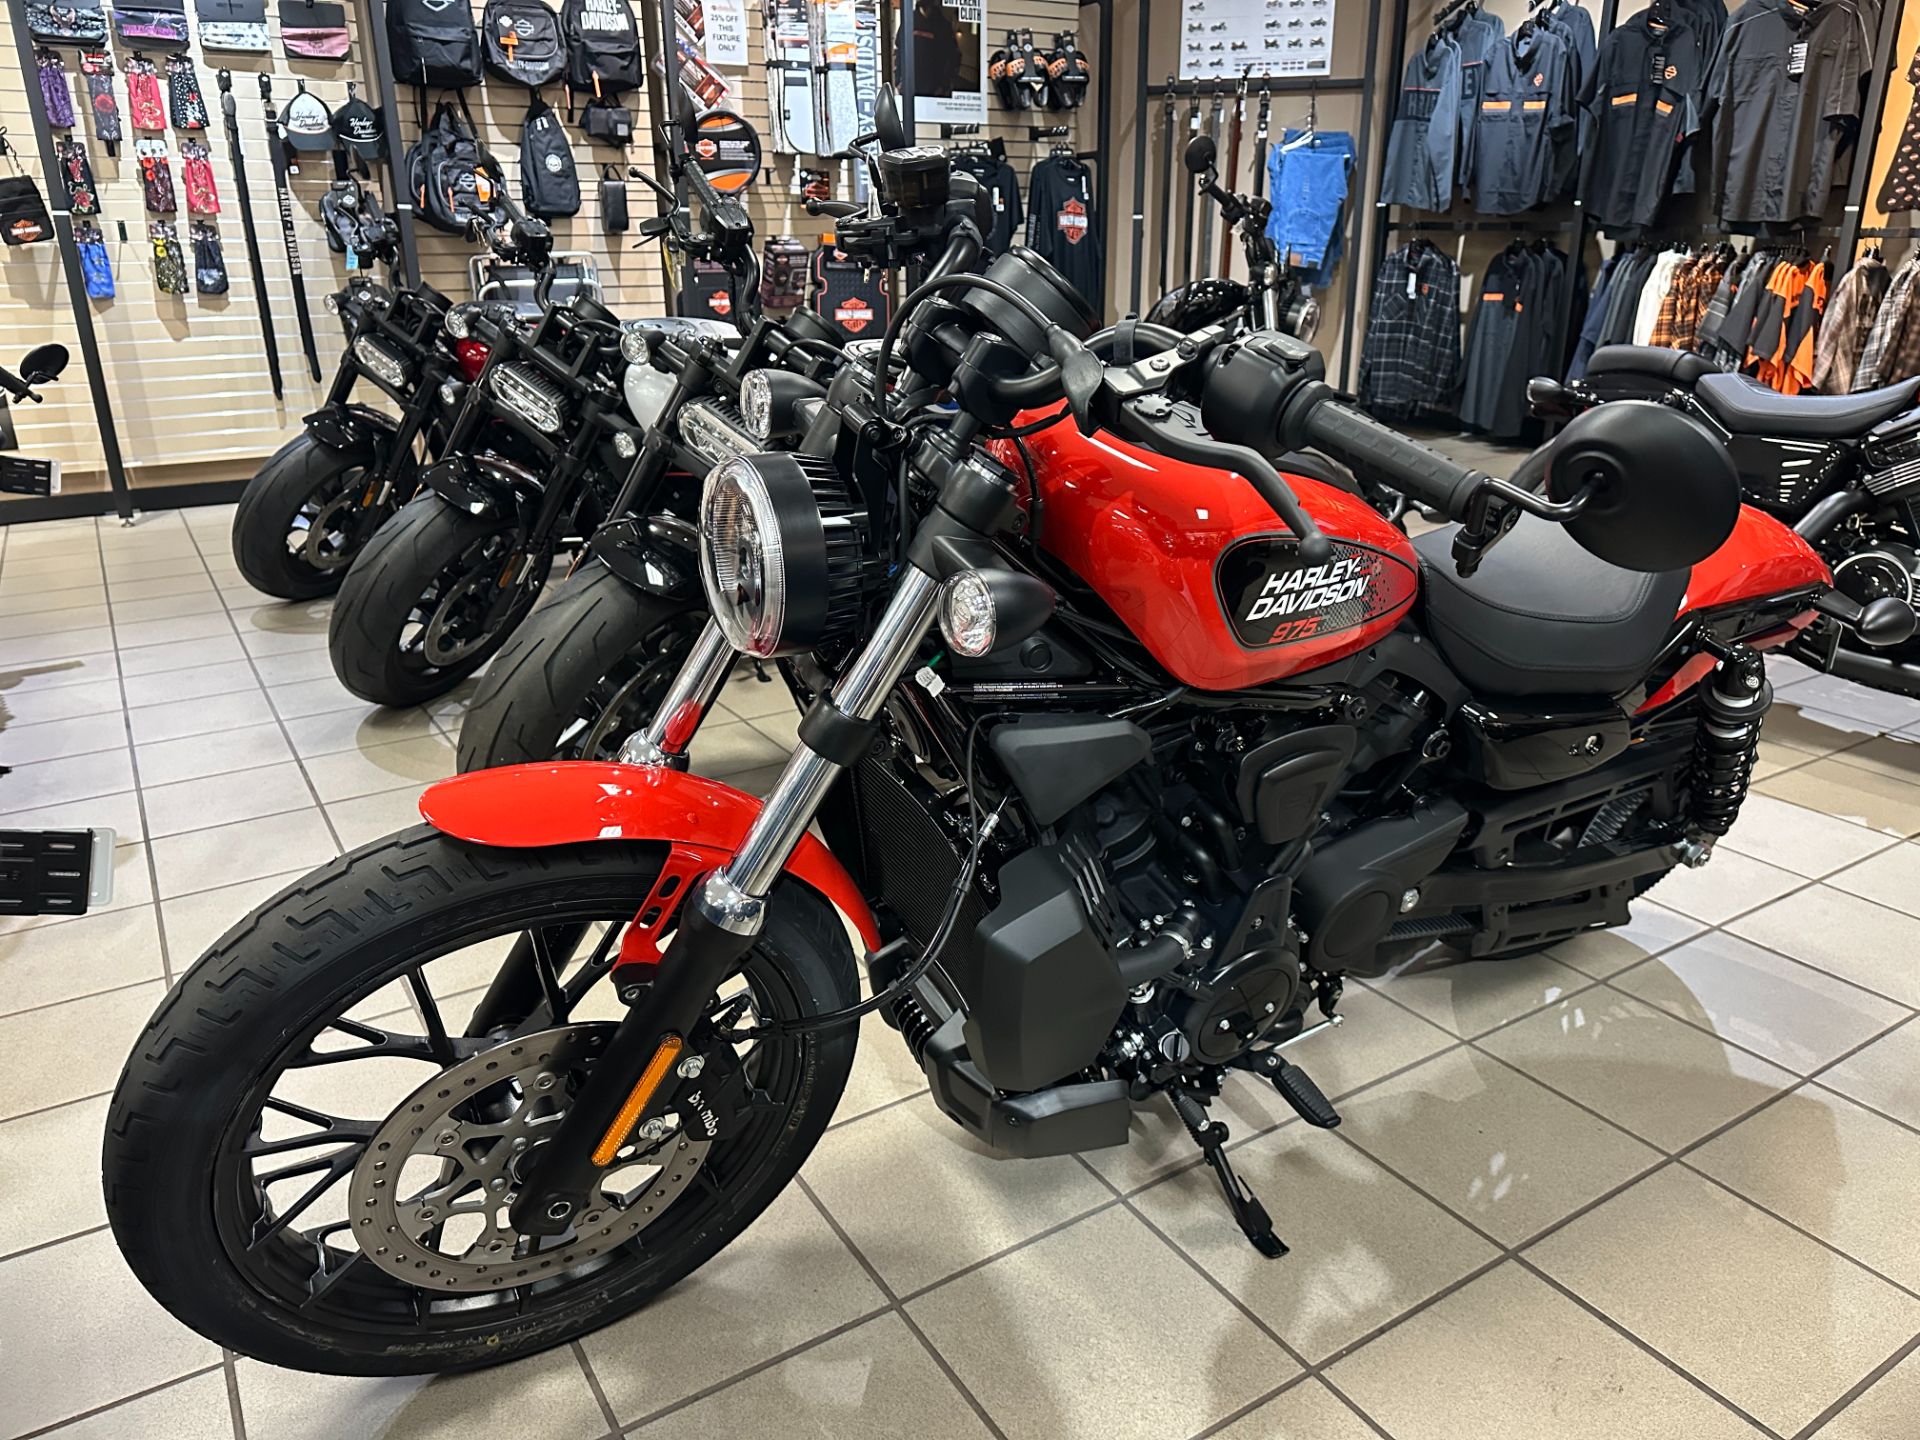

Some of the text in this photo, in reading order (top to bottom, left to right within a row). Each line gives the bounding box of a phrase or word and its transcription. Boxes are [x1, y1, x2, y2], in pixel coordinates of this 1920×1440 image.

[581, 11, 630, 31] DAVIDSON
[711, 14, 724, 22] 25%
[719, 24, 733, 32] THIS
[712, 34, 740, 42] FIXTURE
[718, 43, 736, 51] ONLY
[1260, 556, 1362, 597] HARLEY-
[1245, 575, 1370, 621] DAVIDSON
[1268, 616, 1322, 644] 975
